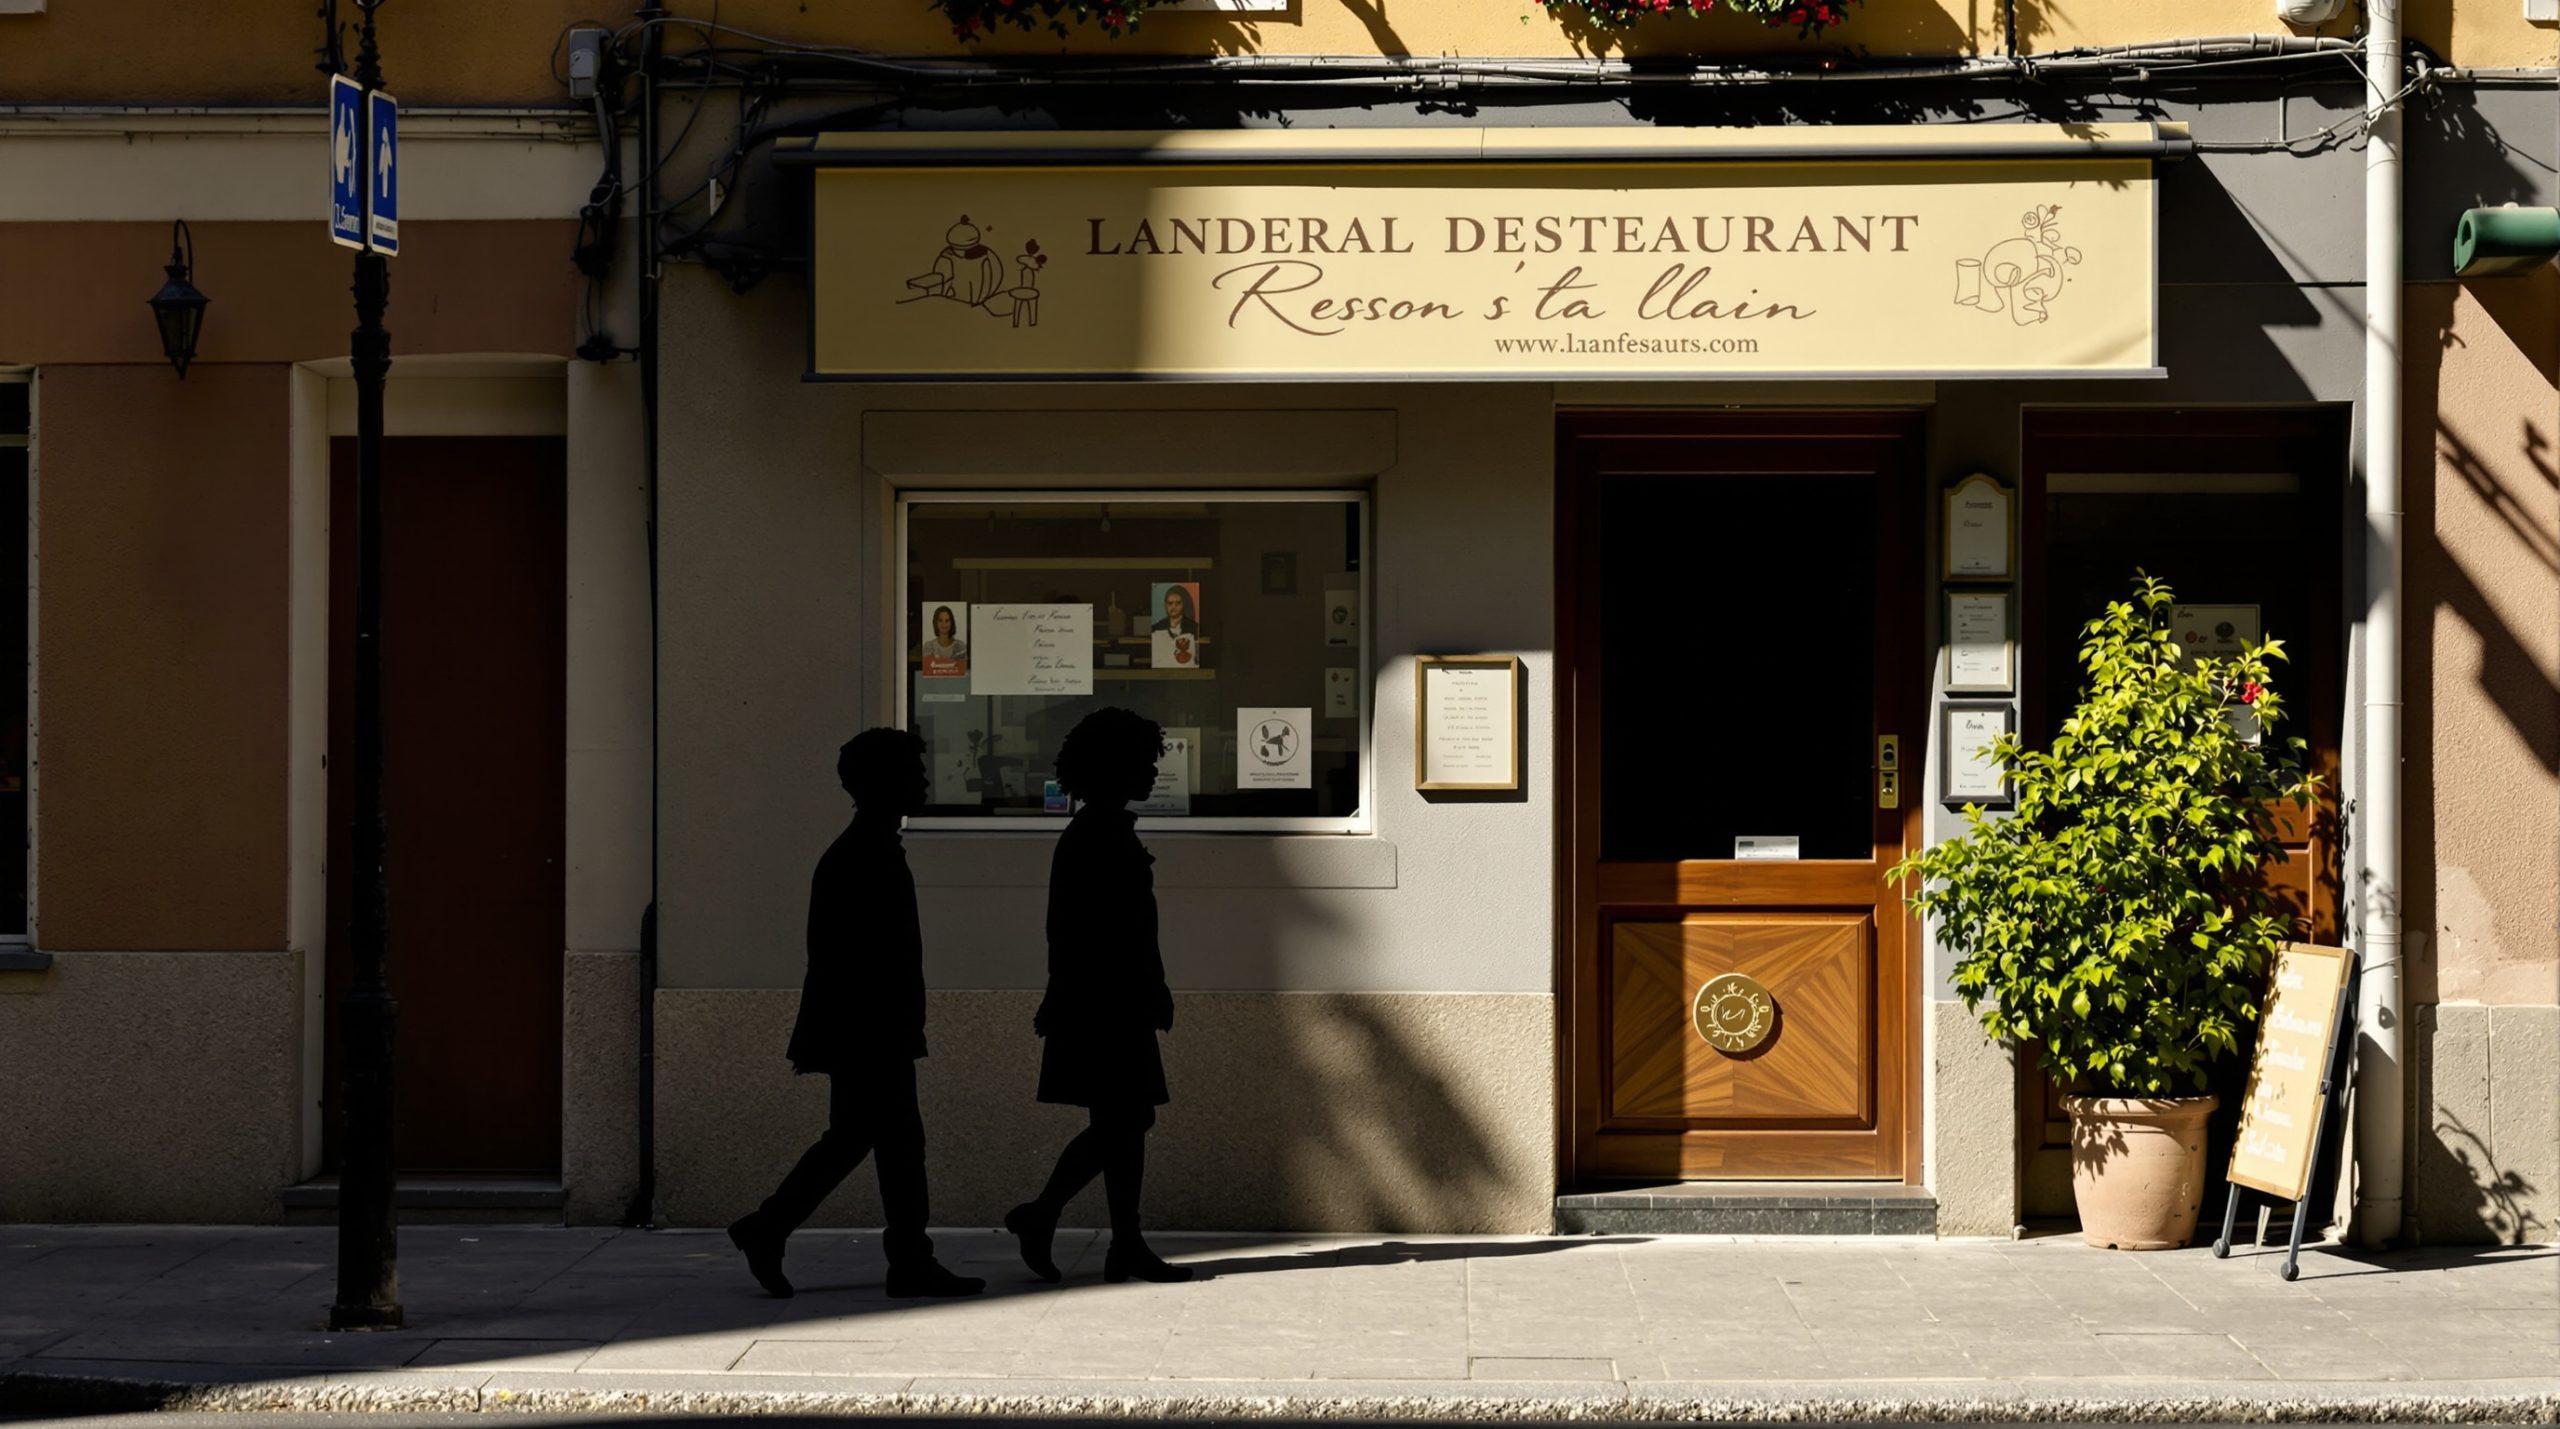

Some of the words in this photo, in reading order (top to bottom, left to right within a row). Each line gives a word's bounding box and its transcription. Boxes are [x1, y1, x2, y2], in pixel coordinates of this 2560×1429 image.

[1086, 217, 1414, 255] LANDERAL
[1444, 215, 1919, 254] DESTEAURANT
[1211, 260, 1464, 336] Resson
